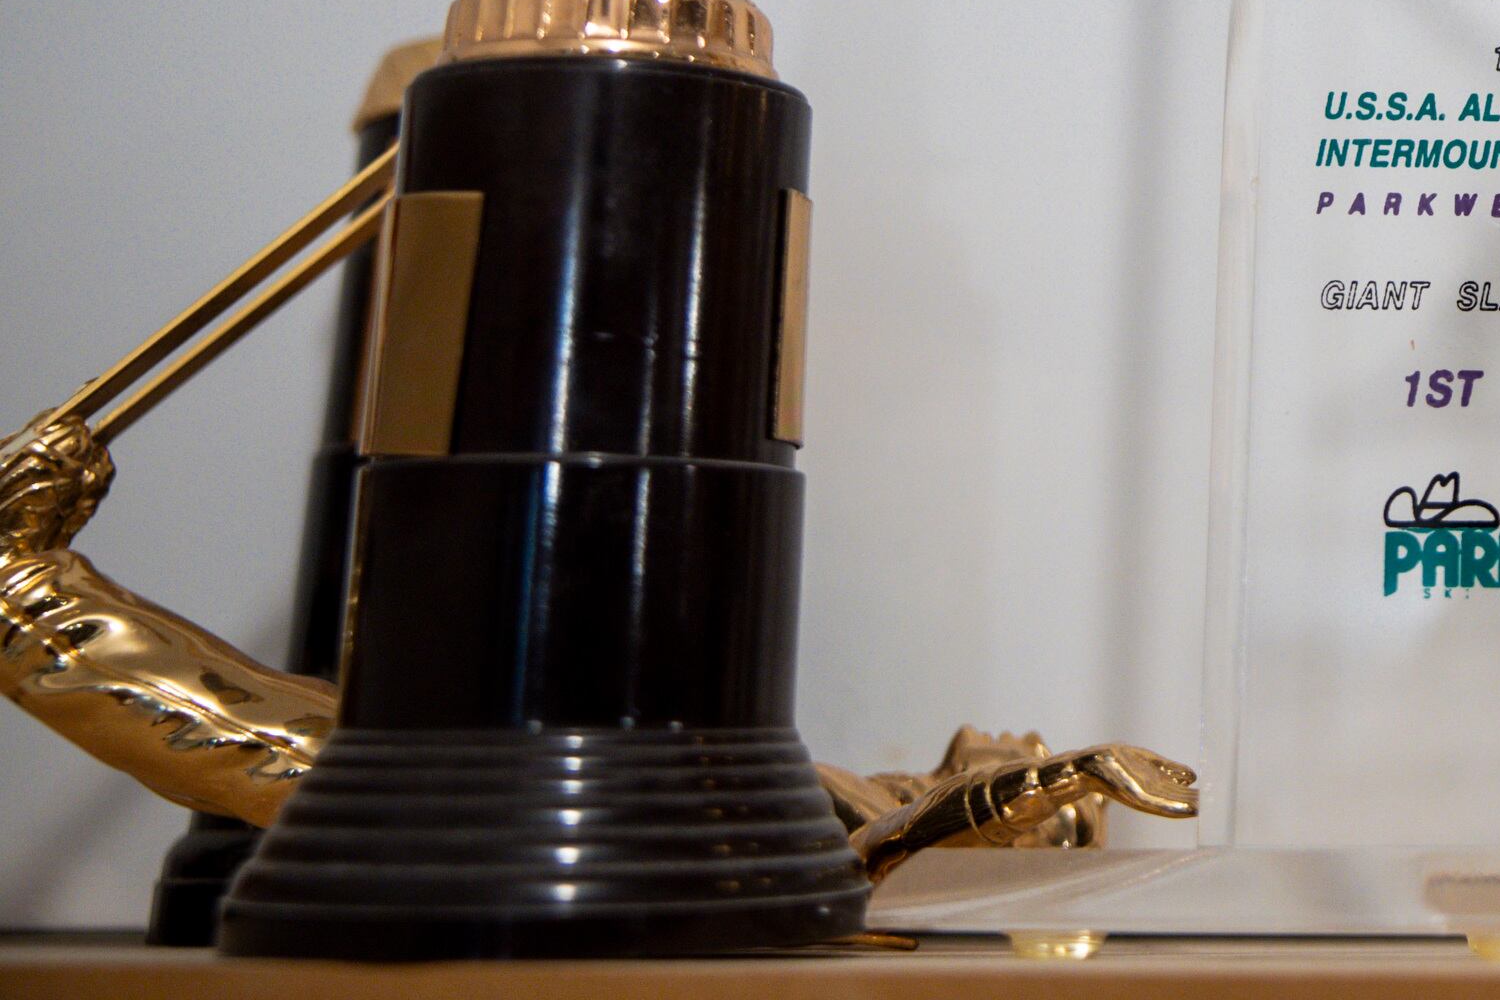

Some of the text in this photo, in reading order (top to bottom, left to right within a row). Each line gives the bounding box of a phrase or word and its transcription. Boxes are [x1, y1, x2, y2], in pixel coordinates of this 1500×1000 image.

[1325, 91, 1445, 121] U.S.S.A.
[1321, 280, 1431, 311] GIANT
[1405, 369, 1484, 408] 1ST
